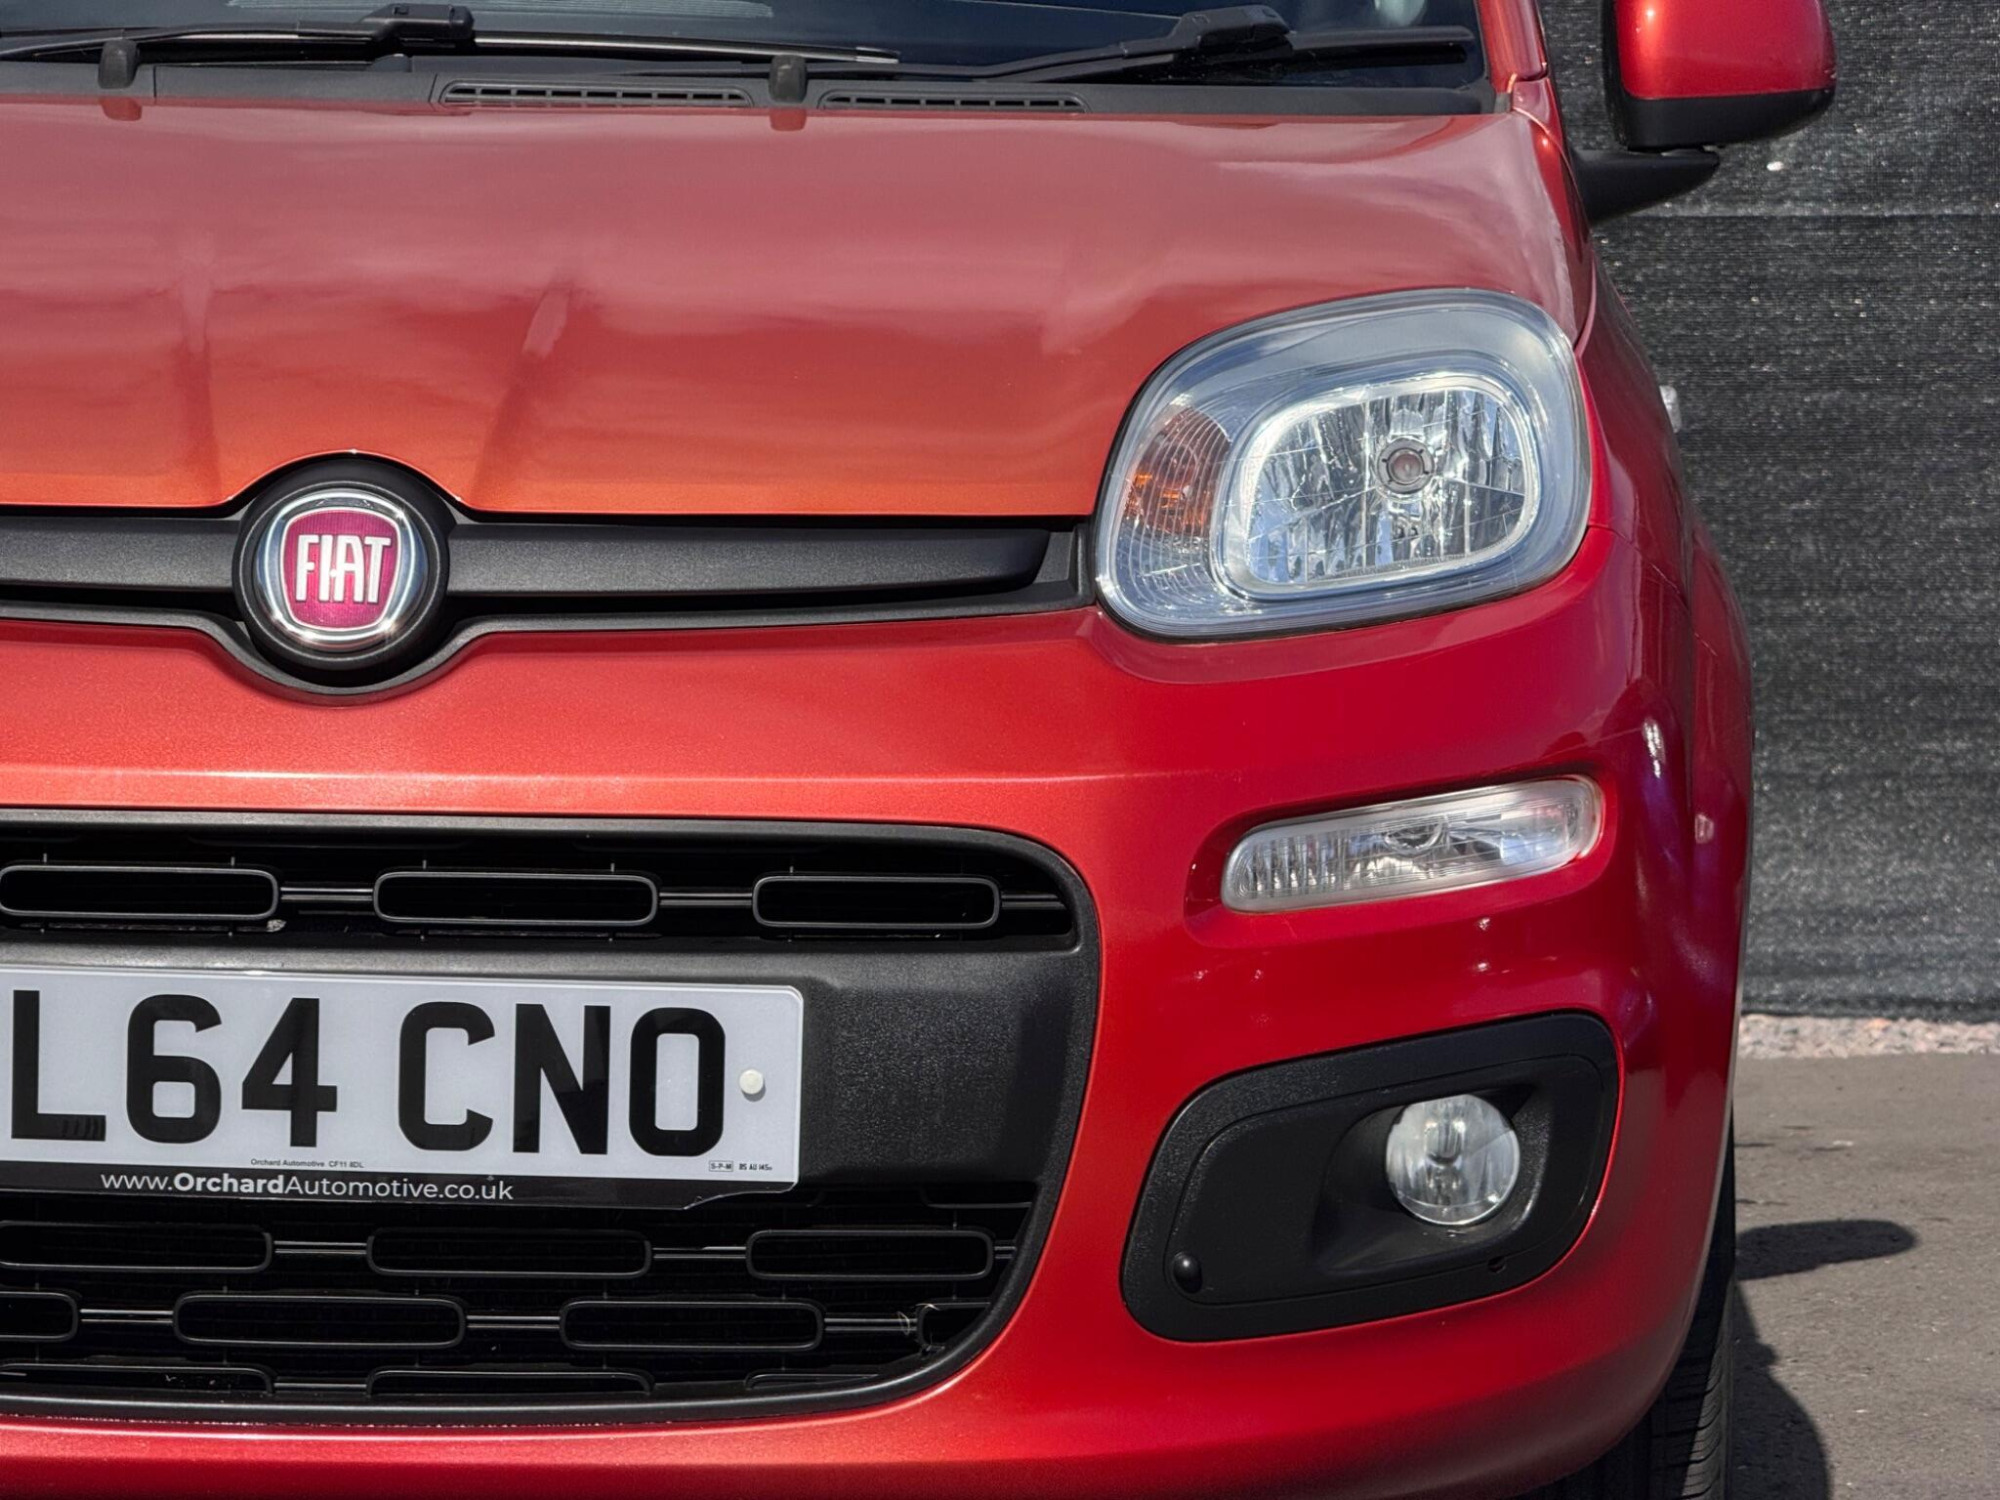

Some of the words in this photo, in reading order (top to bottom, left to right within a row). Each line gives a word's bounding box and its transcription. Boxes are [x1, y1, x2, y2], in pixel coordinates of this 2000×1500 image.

[296, 535, 391, 603] FIAT
[11, 989, 338, 1148] L64
[398, 1001, 726, 1157] CNO
[100, 1172, 514, 1200] www.OrchardAutomotive.co.uk
[250, 1158, 280, 1166] Orchard
[283, 1160, 325, 1168] Automotive
[328, 1160, 347, 1168] CF11
